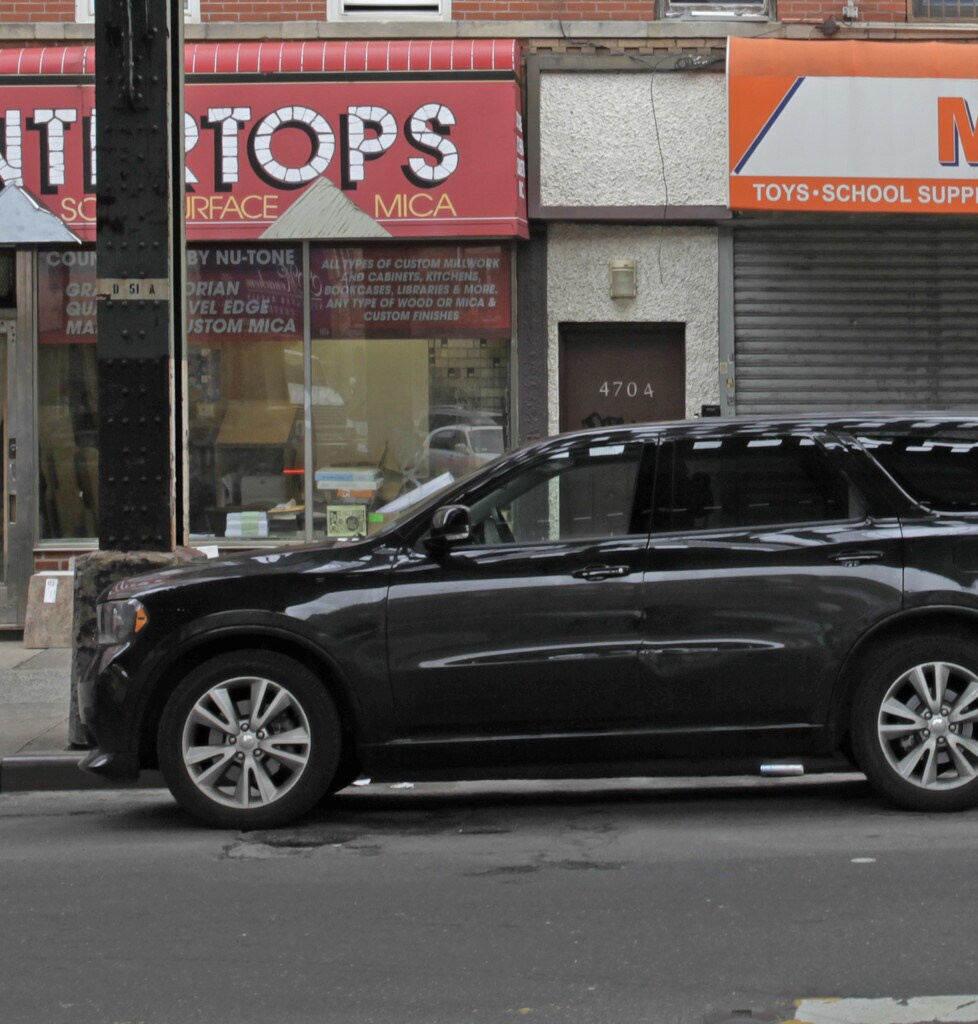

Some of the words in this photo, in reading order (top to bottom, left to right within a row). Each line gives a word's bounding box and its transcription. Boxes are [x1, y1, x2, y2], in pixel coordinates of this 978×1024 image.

[0, 102, 460, 186] TTOPS
[752, 183, 810, 202] TOYS
[821, 184, 912, 204] SCHOOL
[185, 194, 279, 220] RFACE
[375, 192, 457, 218] MICA
[216, 249, 295, 266] NU-TONE
[321, 260, 340, 269] ALL
[343, 259, 374, 269] TYPES
[377, 259, 391, 269] OF
[395, 258, 440, 269] CUSTOM
[443, 258, 500, 269] MILLWORK
[341, 273, 365, 282] AND
[368, 272, 424, 283] CABINETS,
[426, 272, 482, 283] KITCHENS,
[149, 284, 155, 295] A
[187, 282, 240, 296] ORIAN
[325, 285, 394, 295] BOOKCASES,
[397, 285, 449, 294] LIBRARIES
[453, 285, 461, 294] &
[465, 284, 498, 294] MORE.
[223, 300, 270, 315] EDGE
[326, 298, 349, 308] ANY
[353, 298, 377, 308] TYPE
[380, 298, 395, 308] OF
[398, 298, 433, 308] WOOD
[437, 298, 453, 308] OR
[456, 297, 485, 308] MICA
[488, 298, 496, 307] &
[364, 311, 409, 321] CUSTOM
[412, 311, 460, 321] FINISHES
[247, 318, 297, 333] MICA
[599, 381, 655, 398] 4704
